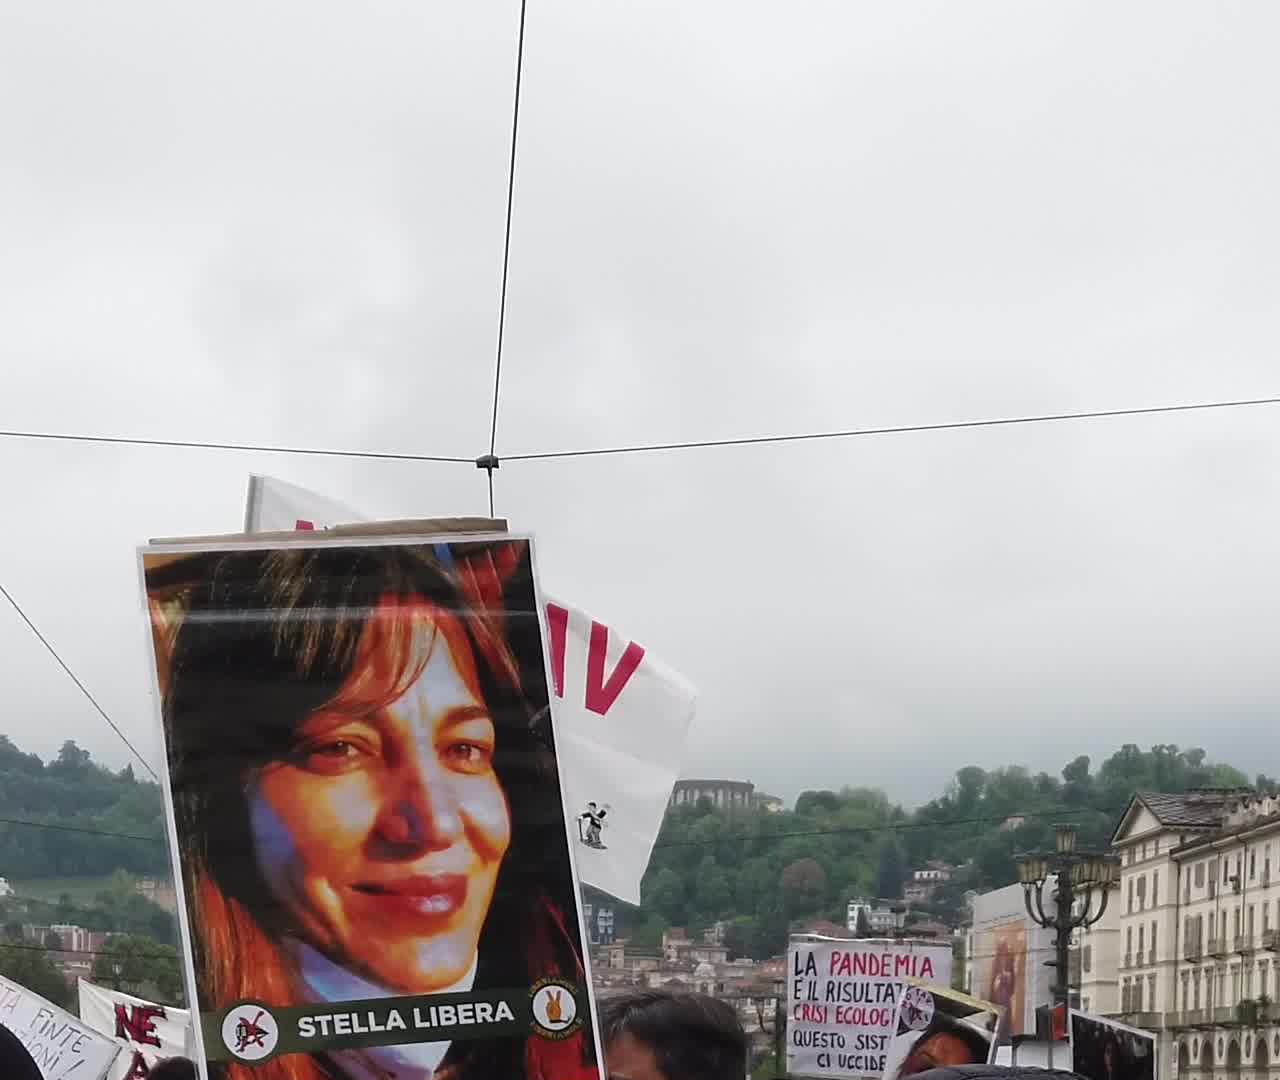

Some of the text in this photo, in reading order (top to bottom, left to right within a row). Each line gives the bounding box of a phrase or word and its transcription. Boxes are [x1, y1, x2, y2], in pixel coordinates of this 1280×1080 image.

[794, 951, 934, 978] LA PANDEMIA
[807, 980, 819, 1001] IL
[826, 980, 904, 1004] RISULTAT
[297, 1008, 410, 1039] STELLA
[413, 1000, 515, 1030] LIBERA
[793, 1006, 895, 1027] CRISI ECOLOGI
[793, 1029, 892, 1050] QUESTO SIST
[817, 1052, 887, 1072] CI UCCIDE
